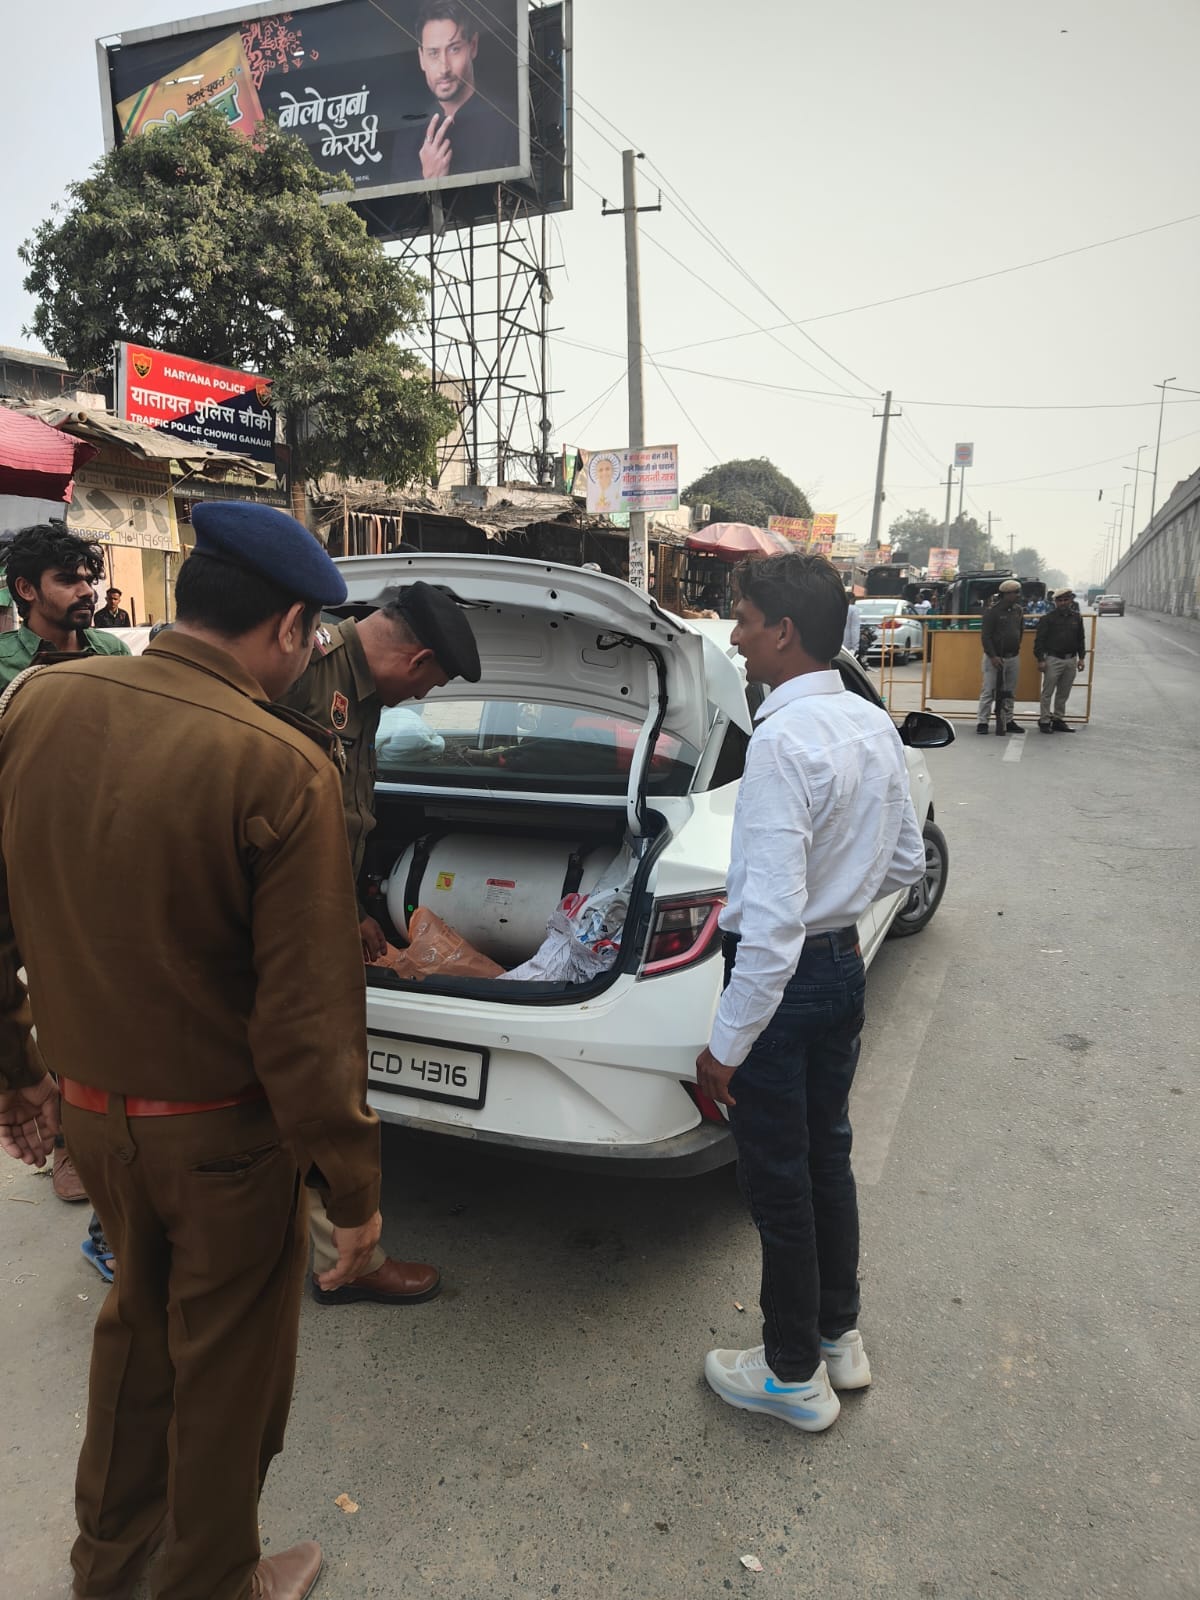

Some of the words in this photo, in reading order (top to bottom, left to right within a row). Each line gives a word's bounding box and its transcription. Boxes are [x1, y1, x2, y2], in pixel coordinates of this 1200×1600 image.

[278, 87, 327, 128] बोलो
[318, 114, 383, 166] केसरी
[163, 367, 211, 387] HARYANA
[213, 378, 246, 394] POLICE
[130, 386, 191, 415] यातायत
[194, 397, 235, 425] पुलिस
[238, 406, 273, 431] चौकी
[130, 413, 169, 428] TRAFFIC
[171, 421, 202, 435] POLICE
[204, 426, 238, 442] CHOWKI
[239, 434, 272, 448] GANAUR
[411, 1058, 467, 1087] 4316
